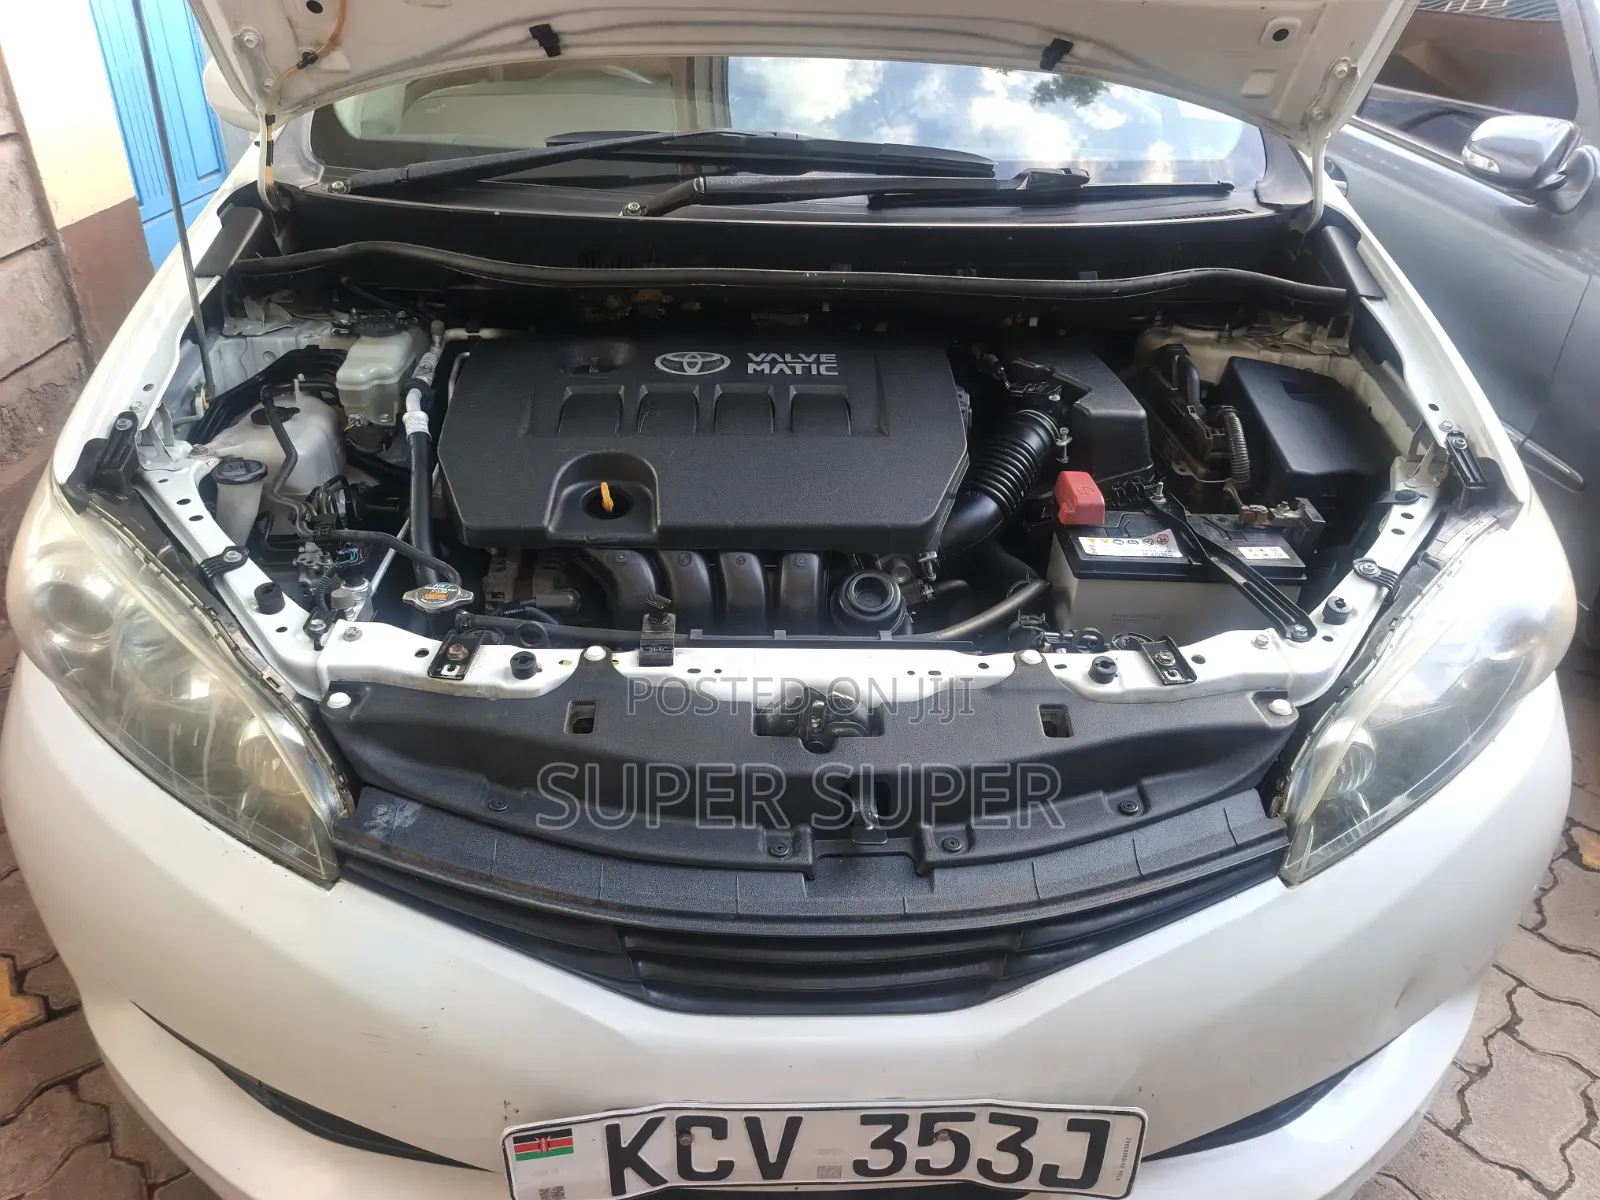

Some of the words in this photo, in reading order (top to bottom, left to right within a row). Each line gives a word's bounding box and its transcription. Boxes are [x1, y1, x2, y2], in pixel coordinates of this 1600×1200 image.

[747, 352, 837, 363] VALVE
[747, 363, 839, 375] MATIC
[605, 1115, 804, 1196] KCV
[852, 1111, 1111, 1190] 353J
